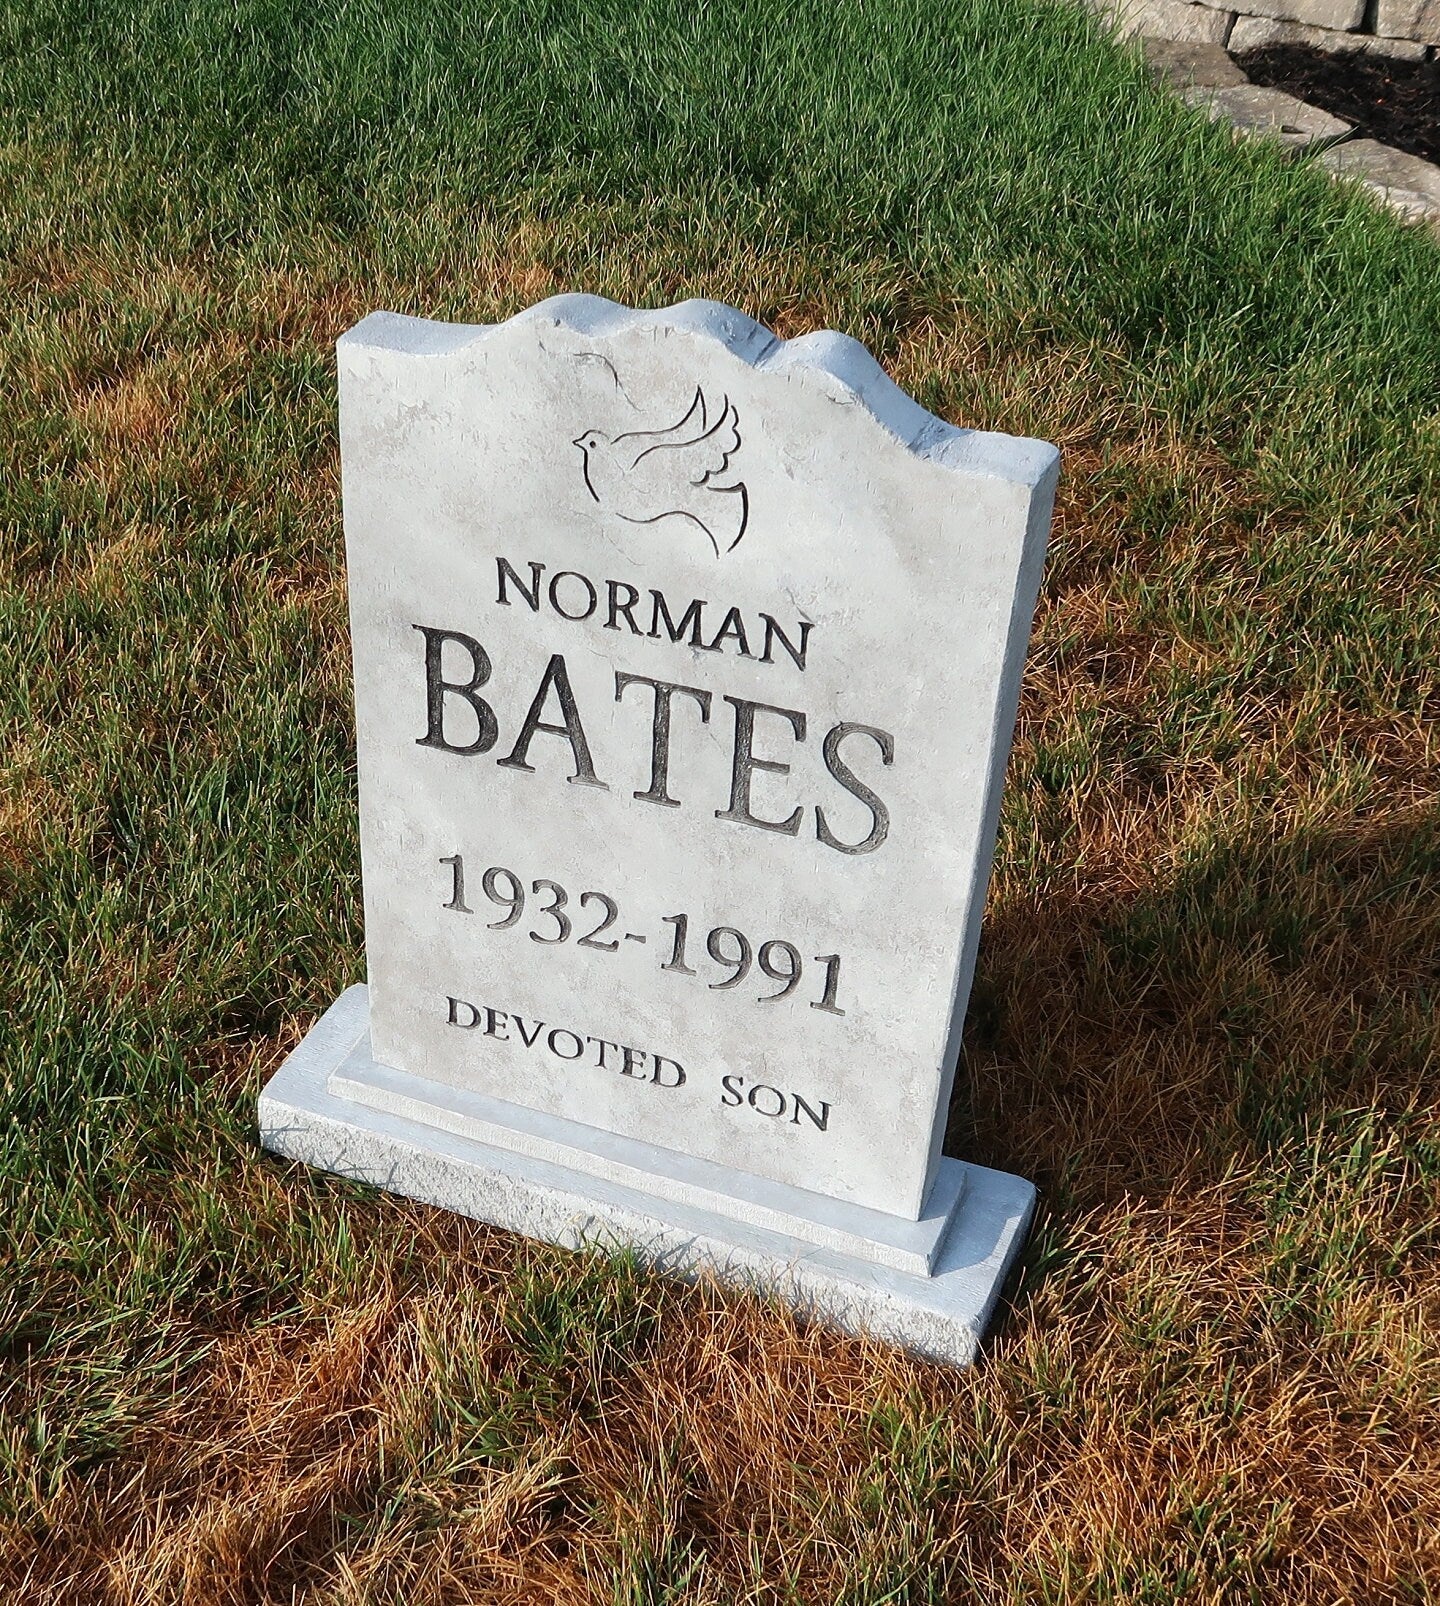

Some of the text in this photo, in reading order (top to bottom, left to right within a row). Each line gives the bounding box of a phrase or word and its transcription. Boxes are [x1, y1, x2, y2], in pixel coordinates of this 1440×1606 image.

[495, 556, 815, 672] NORMAN
[412, 623, 895, 856] BATES
[438, 854, 846, 1016] 1932-1991
[445, 995, 832, 1132] DEVOTED SON
